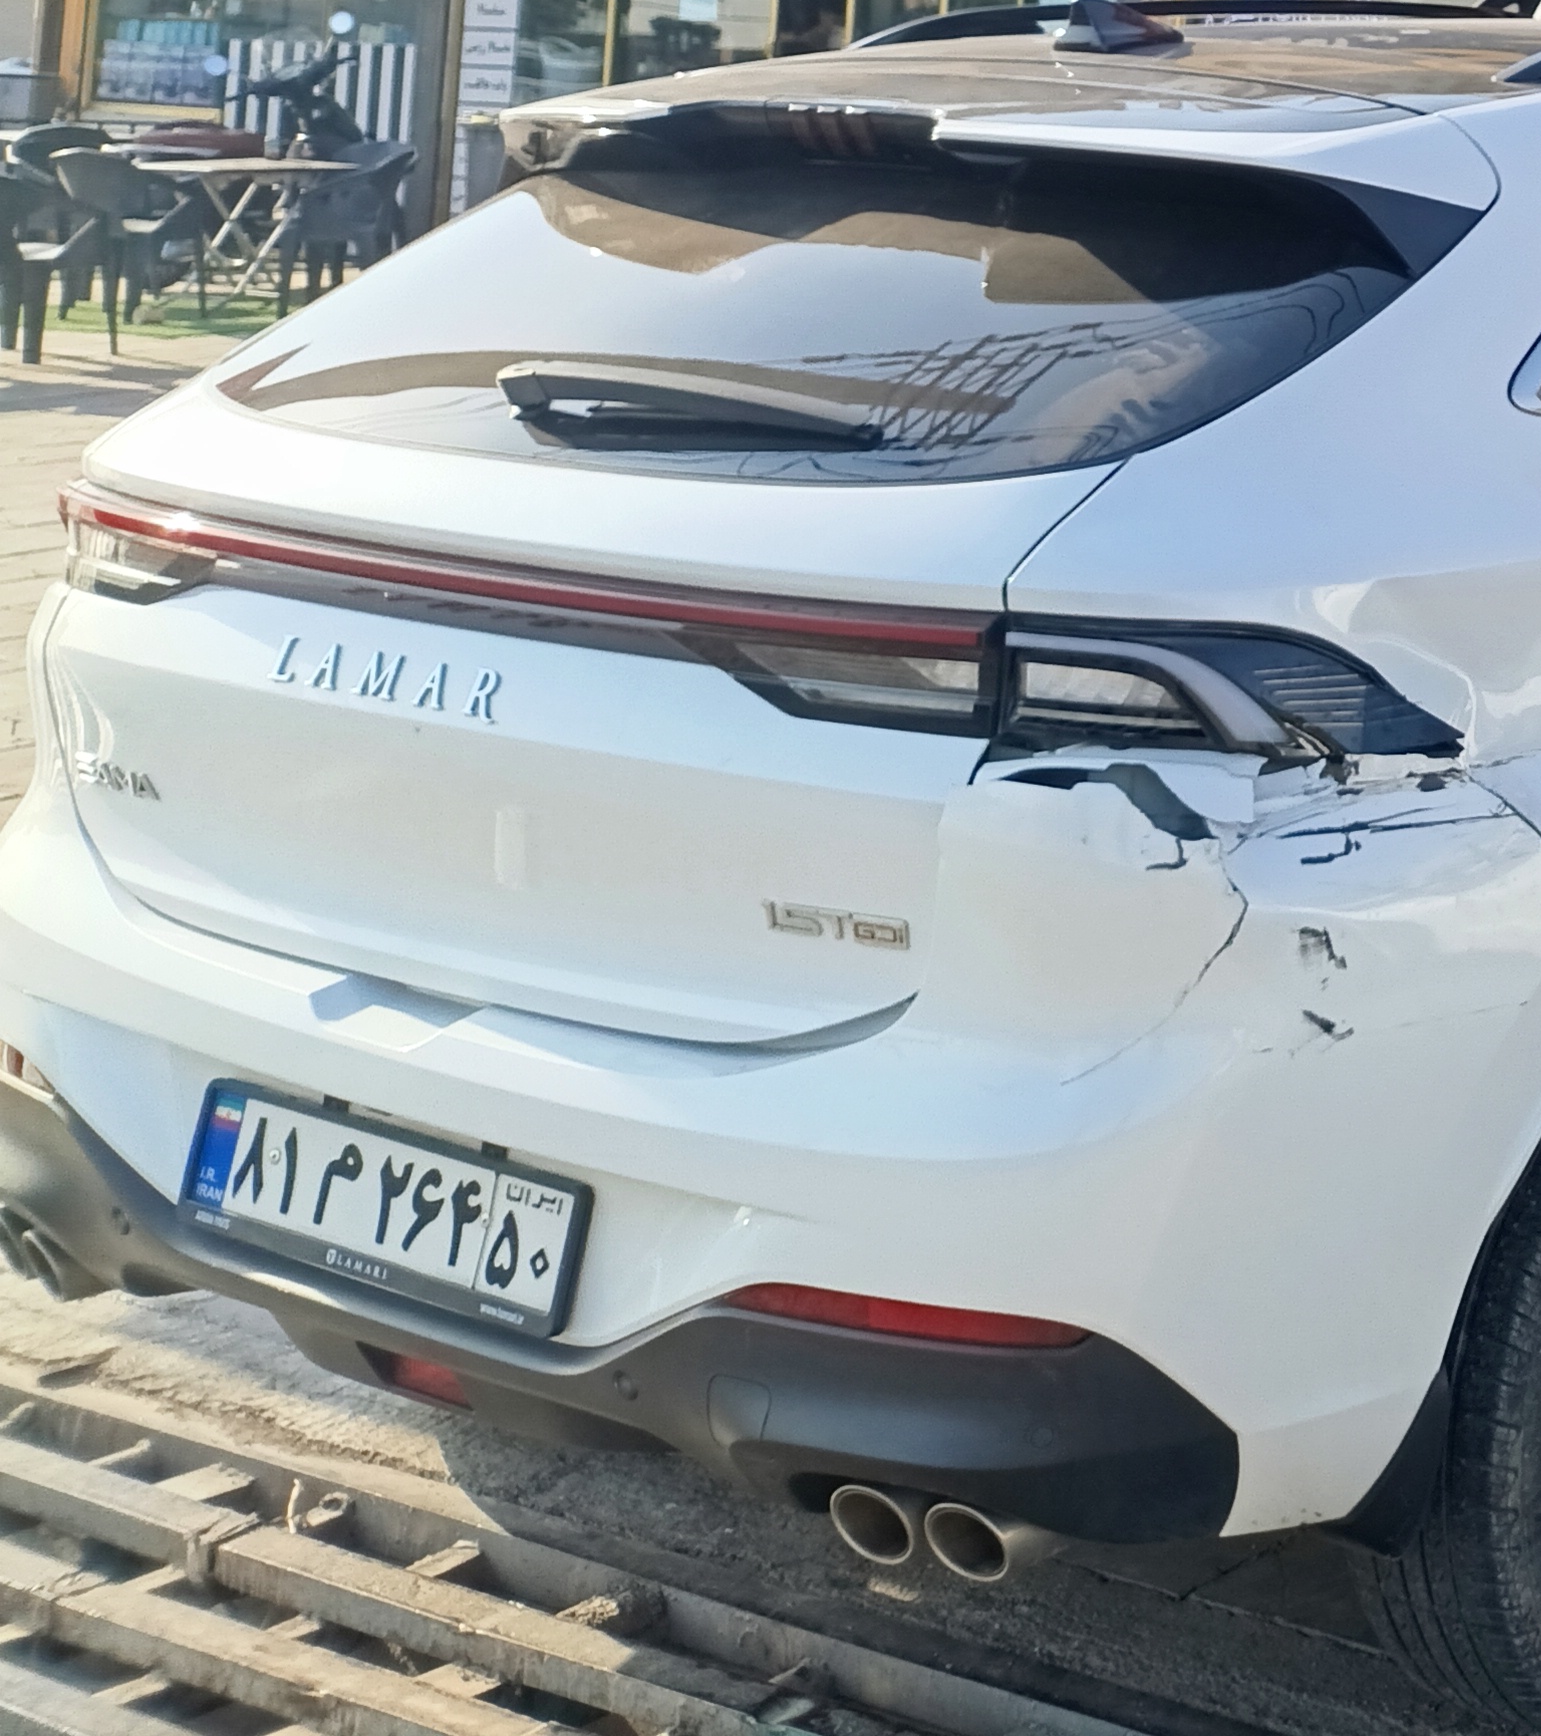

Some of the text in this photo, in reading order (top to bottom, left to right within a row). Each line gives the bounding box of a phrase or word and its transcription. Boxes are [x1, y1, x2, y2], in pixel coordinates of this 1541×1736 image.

[266, 633, 502, 725] LAMAR
[231, 1116, 551, 1290] ۸۱ م ۲۶۴ ۵۰
[505, 1181, 564, 1216] ایران
[336, 1253, 387, 1280] LAMARI
